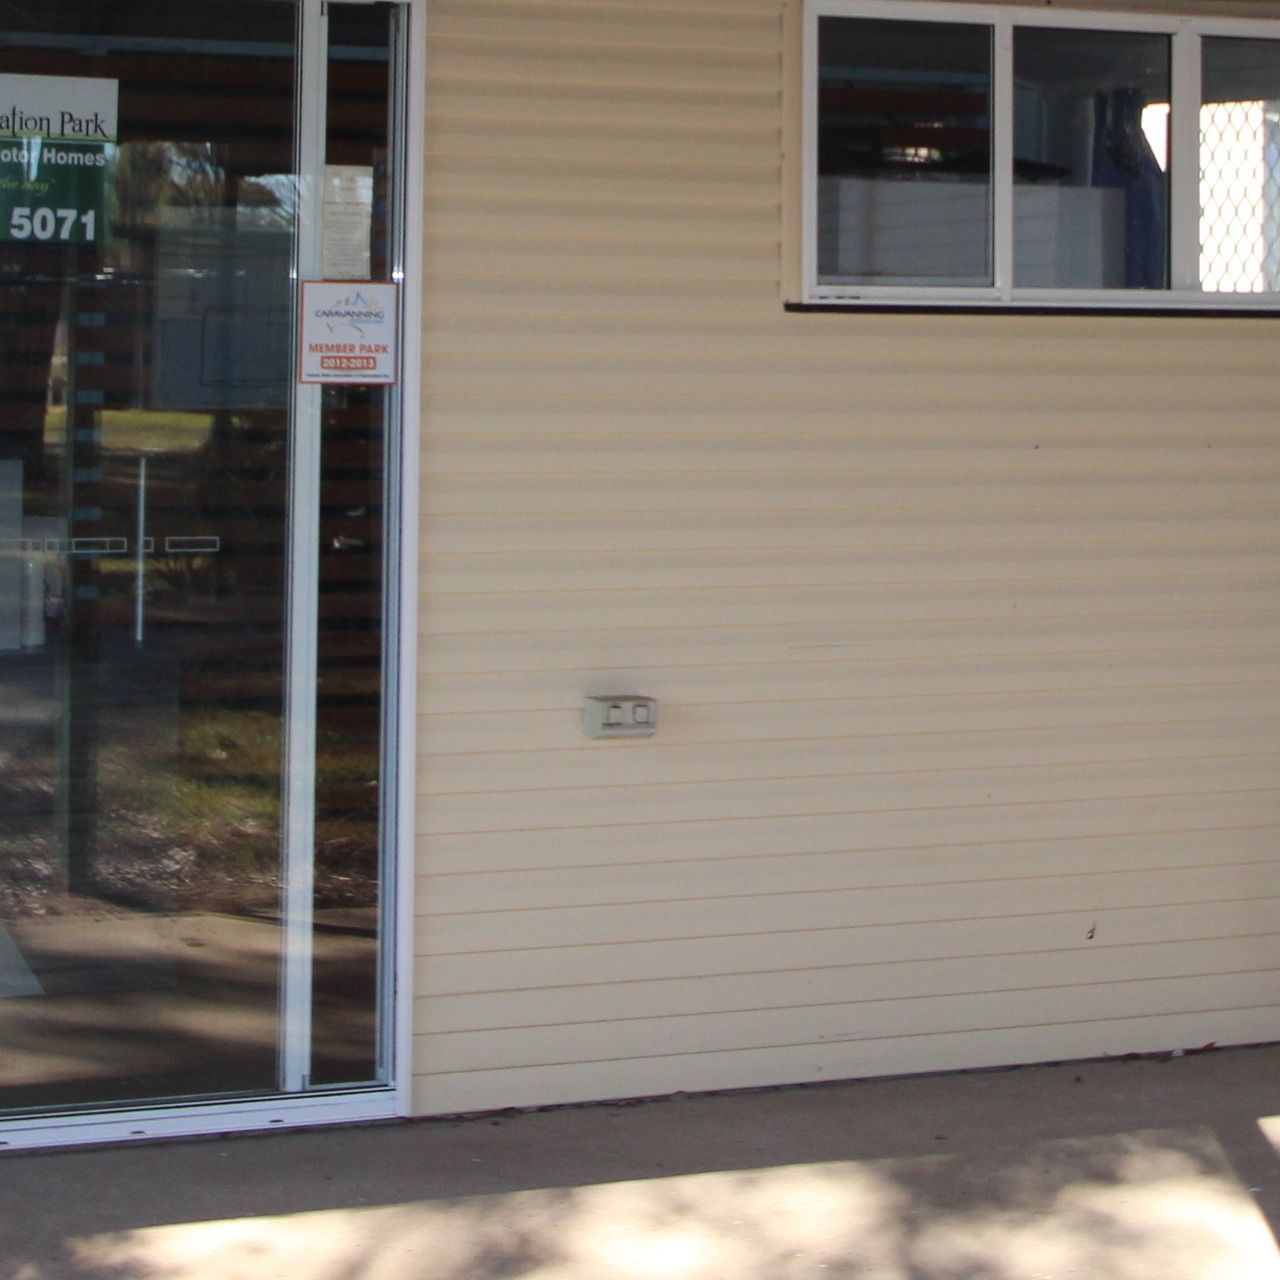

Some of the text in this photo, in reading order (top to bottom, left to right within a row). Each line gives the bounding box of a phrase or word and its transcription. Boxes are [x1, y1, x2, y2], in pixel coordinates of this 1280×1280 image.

[59, 111, 110, 138] Park
[42, 146, 106, 167] Homes
[9, 206, 96, 241] 5071
[314, 310, 384, 318] CARAVANNING
[308, 343, 389, 353] MEMBER PARK
